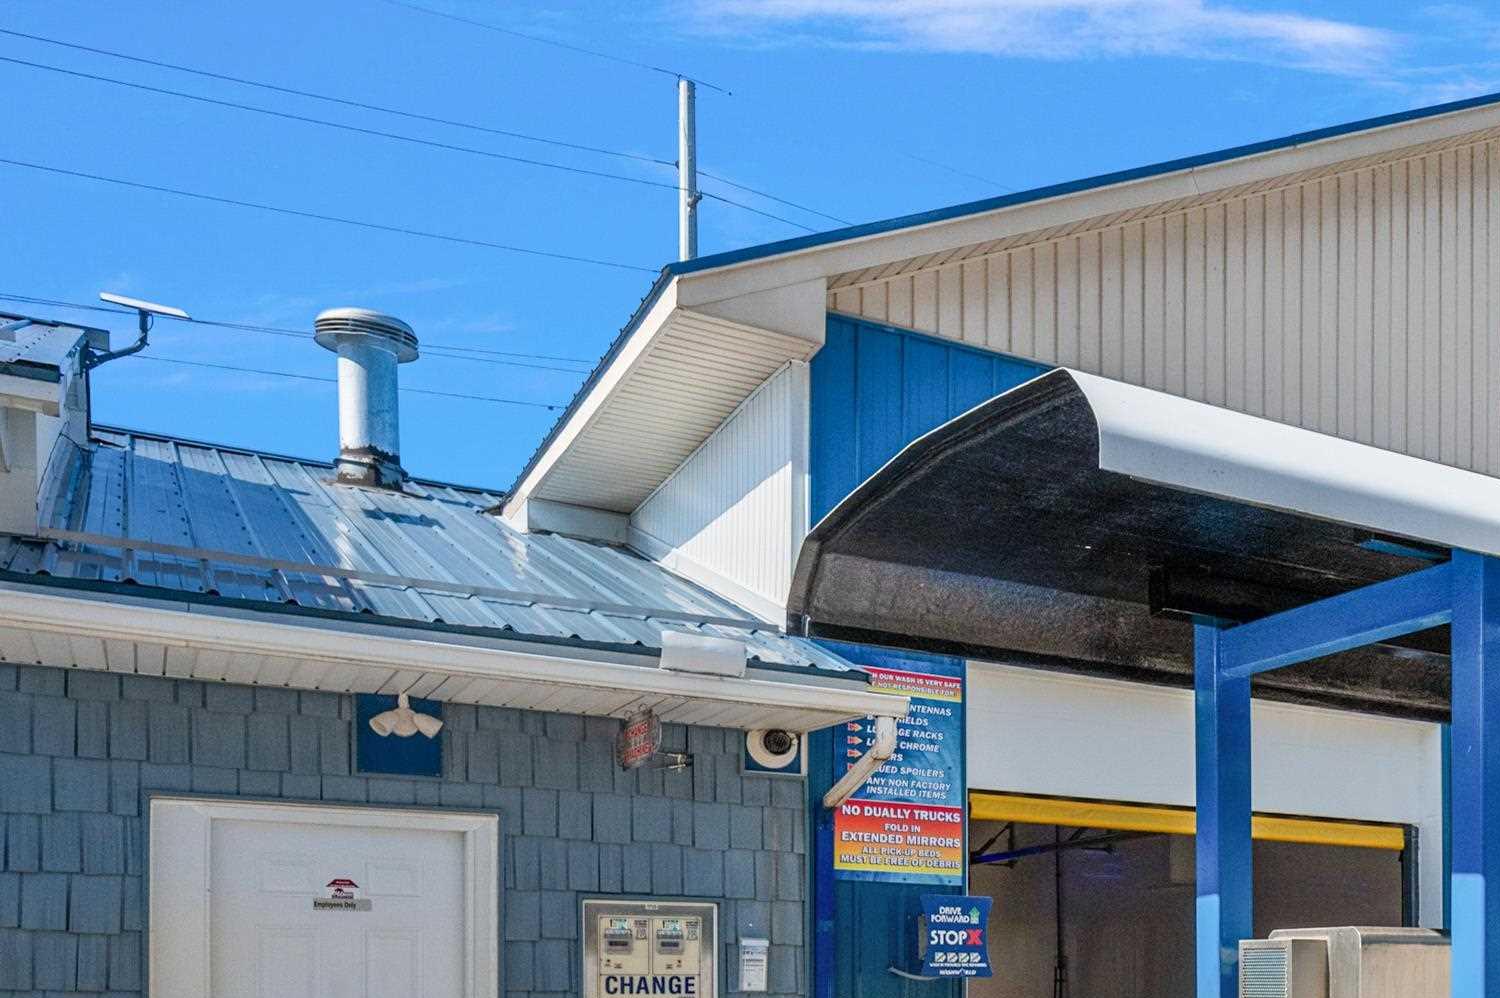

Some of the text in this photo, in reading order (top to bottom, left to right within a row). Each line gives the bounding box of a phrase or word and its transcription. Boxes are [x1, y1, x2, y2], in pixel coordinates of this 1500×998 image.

[895, 675, 916, 684] WASH
[926, 679, 943, 687] VERY
[944, 681, 961, 689] SAFE
[909, 705, 952, 717] NTENNAS
[912, 729, 944, 741] RACKS
[899, 741, 940, 753] CHROME
[900, 767, 945, 778] SPOILERS
[866, 777, 951, 791] ANY NON FACTORY
[866, 786, 947, 800] INSTALLED ITEMS
[842, 805, 961, 823] NO DUALLY TRUCKS
[884, 823, 921, 833] FOLD IN
[842, 831, 961, 848] EXTENDED MIRRORS
[863, 846, 879, 855] ALL
[841, 855, 868, 864] MUST
[885, 857, 909, 866] FREE
[912, 858, 924, 867] OF
[927, 859, 961, 869] DEBRIS
[313, 901, 357, 910] Employees Only
[939, 906, 962, 915] DRIVE
[930, 914, 970, 923] FORWARD
[930, 929, 968, 945] STOP
[605, 975, 696, 995] CHANGE
